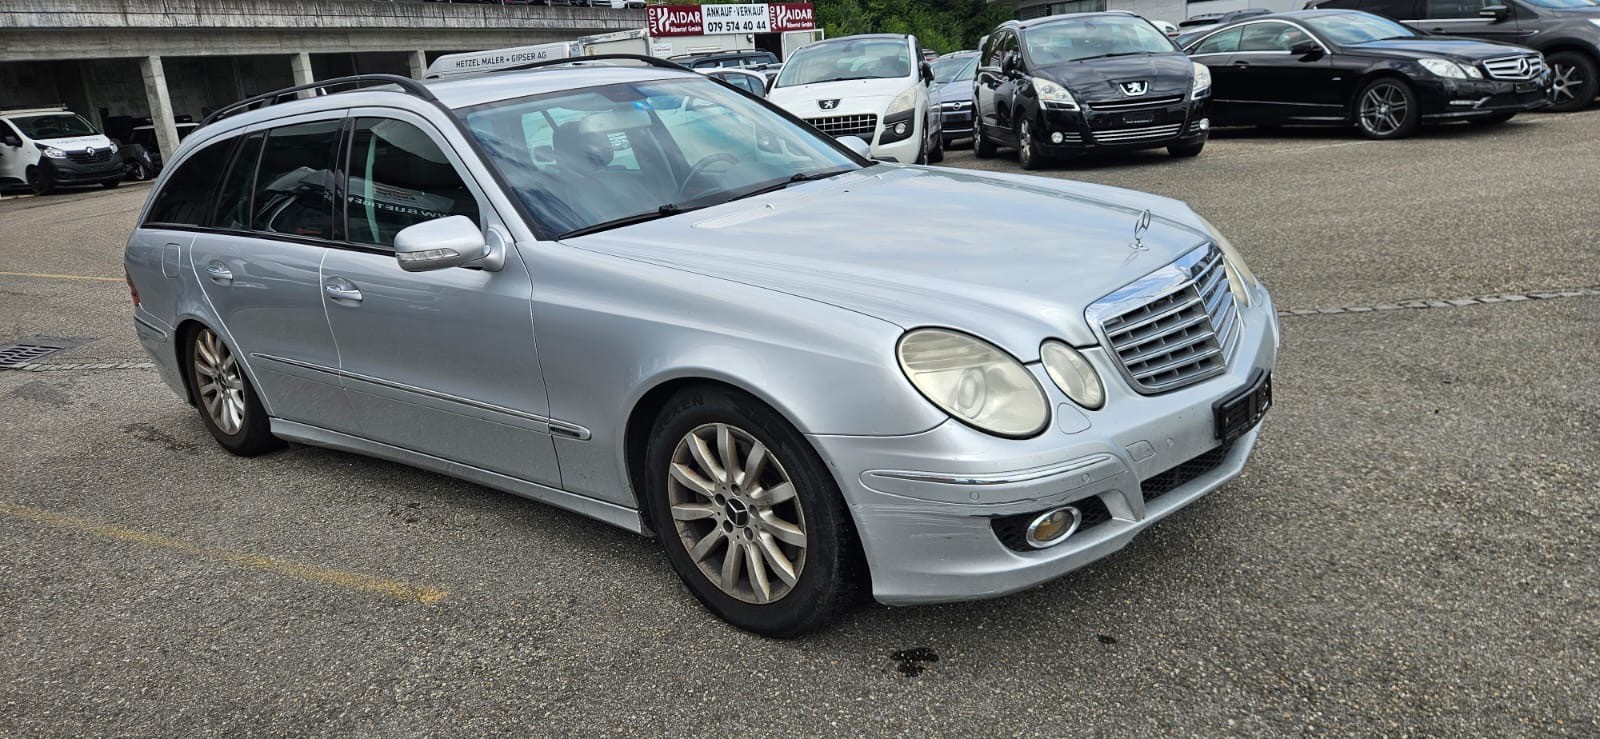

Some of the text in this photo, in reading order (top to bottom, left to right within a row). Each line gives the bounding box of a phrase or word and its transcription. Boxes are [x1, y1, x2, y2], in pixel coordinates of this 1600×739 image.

[649, 8, 658, 34] AUTO
[707, 21, 766, 32] 079 574 40 44
[769, 6, 777, 30] AUTO
[456, 60, 480, 68] HETZEL
[511, 54, 535, 63] GIPSER
